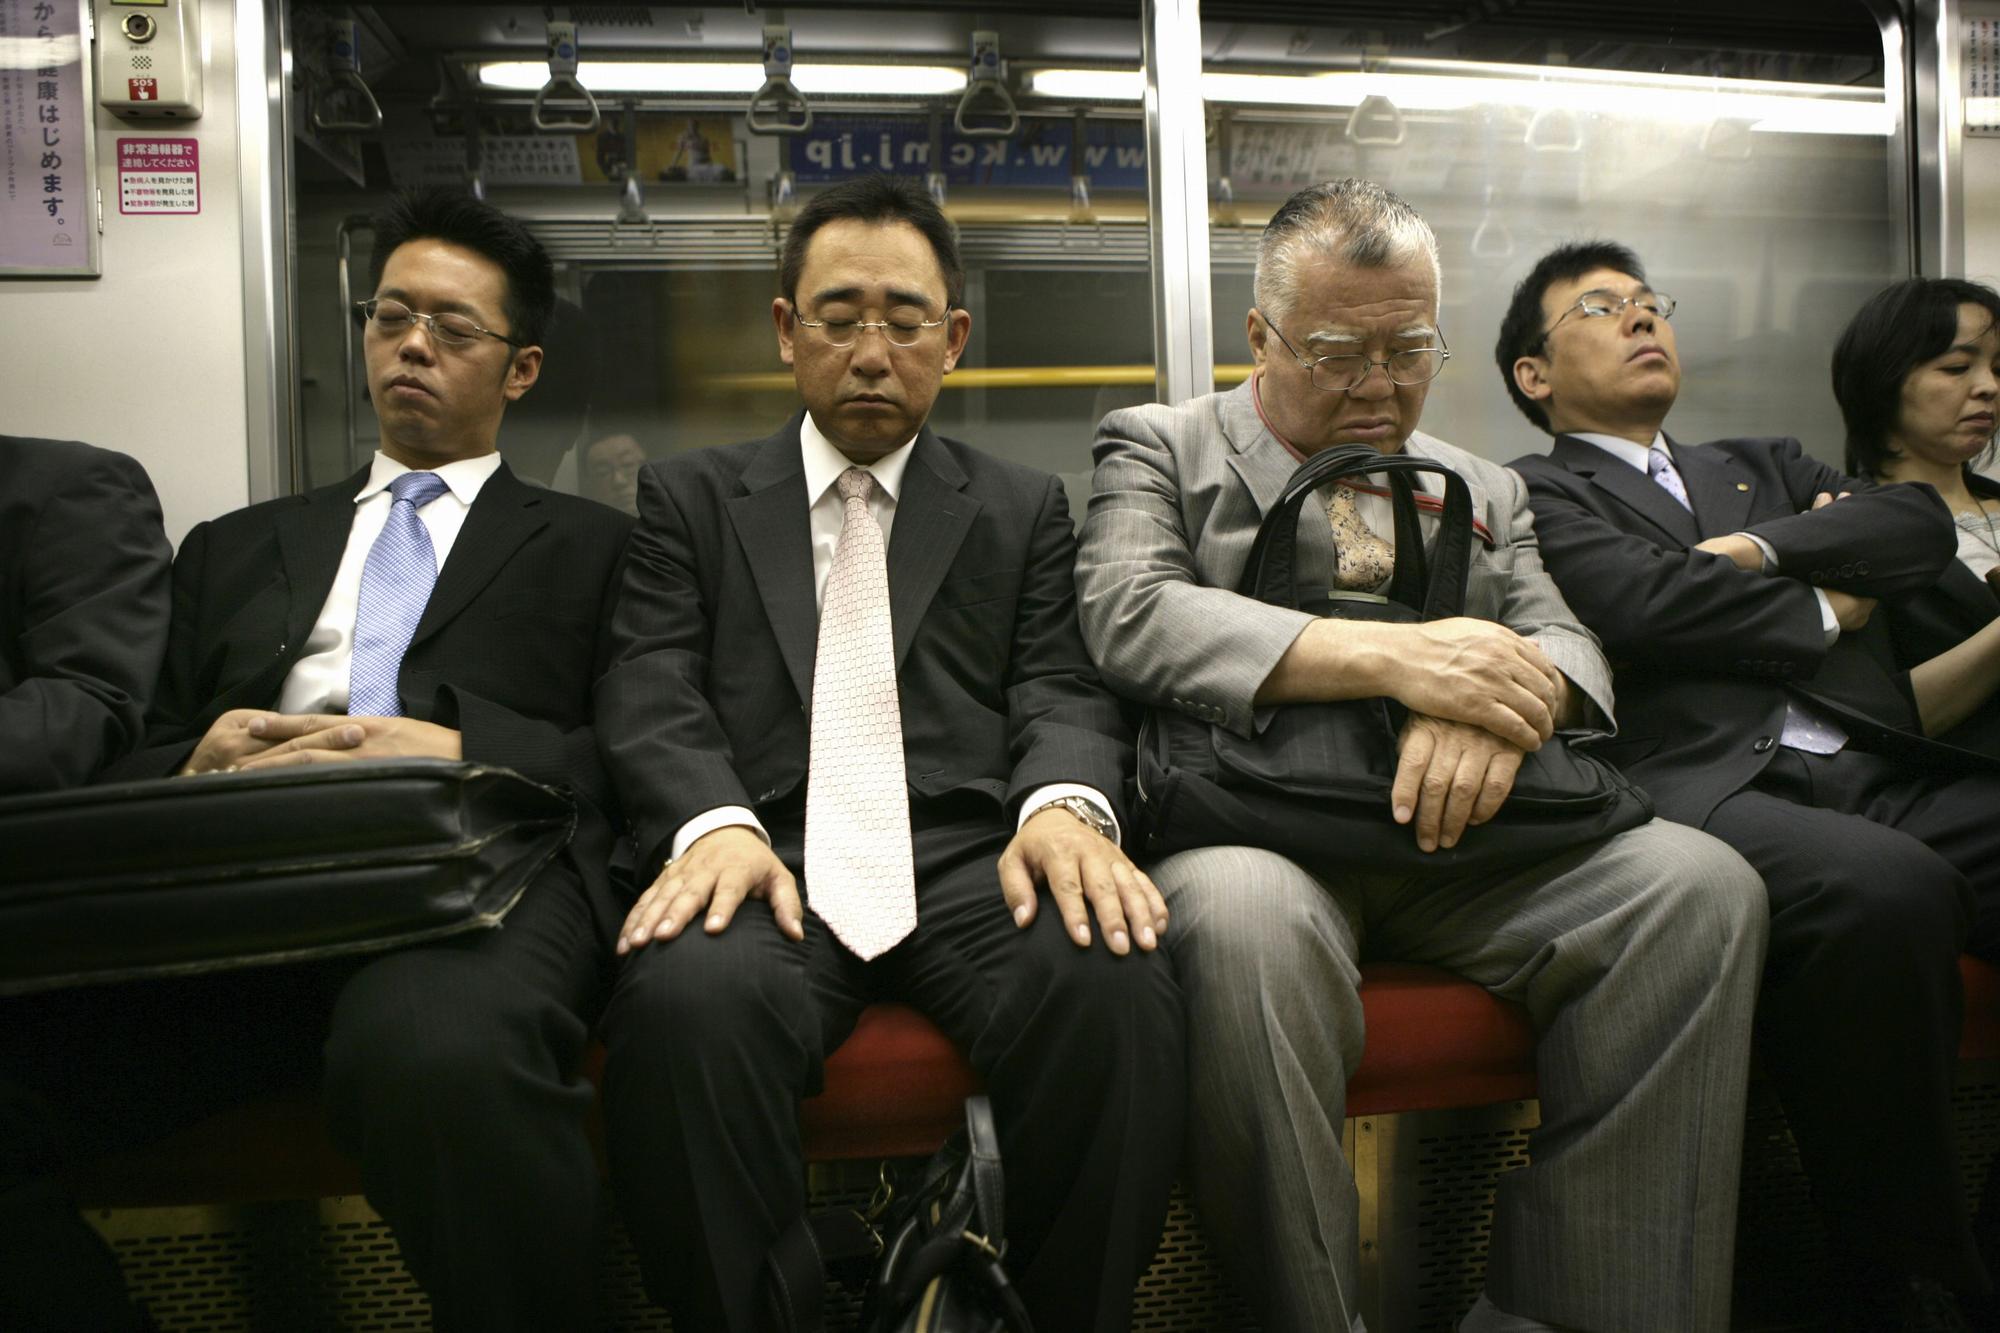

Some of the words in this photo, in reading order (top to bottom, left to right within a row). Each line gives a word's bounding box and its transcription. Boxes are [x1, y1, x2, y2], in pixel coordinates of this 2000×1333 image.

[132, 79, 154, 87] SOS
[123, 144, 193, 155] 非常通報器で
[122, 158, 195, 168] 連絡してください
